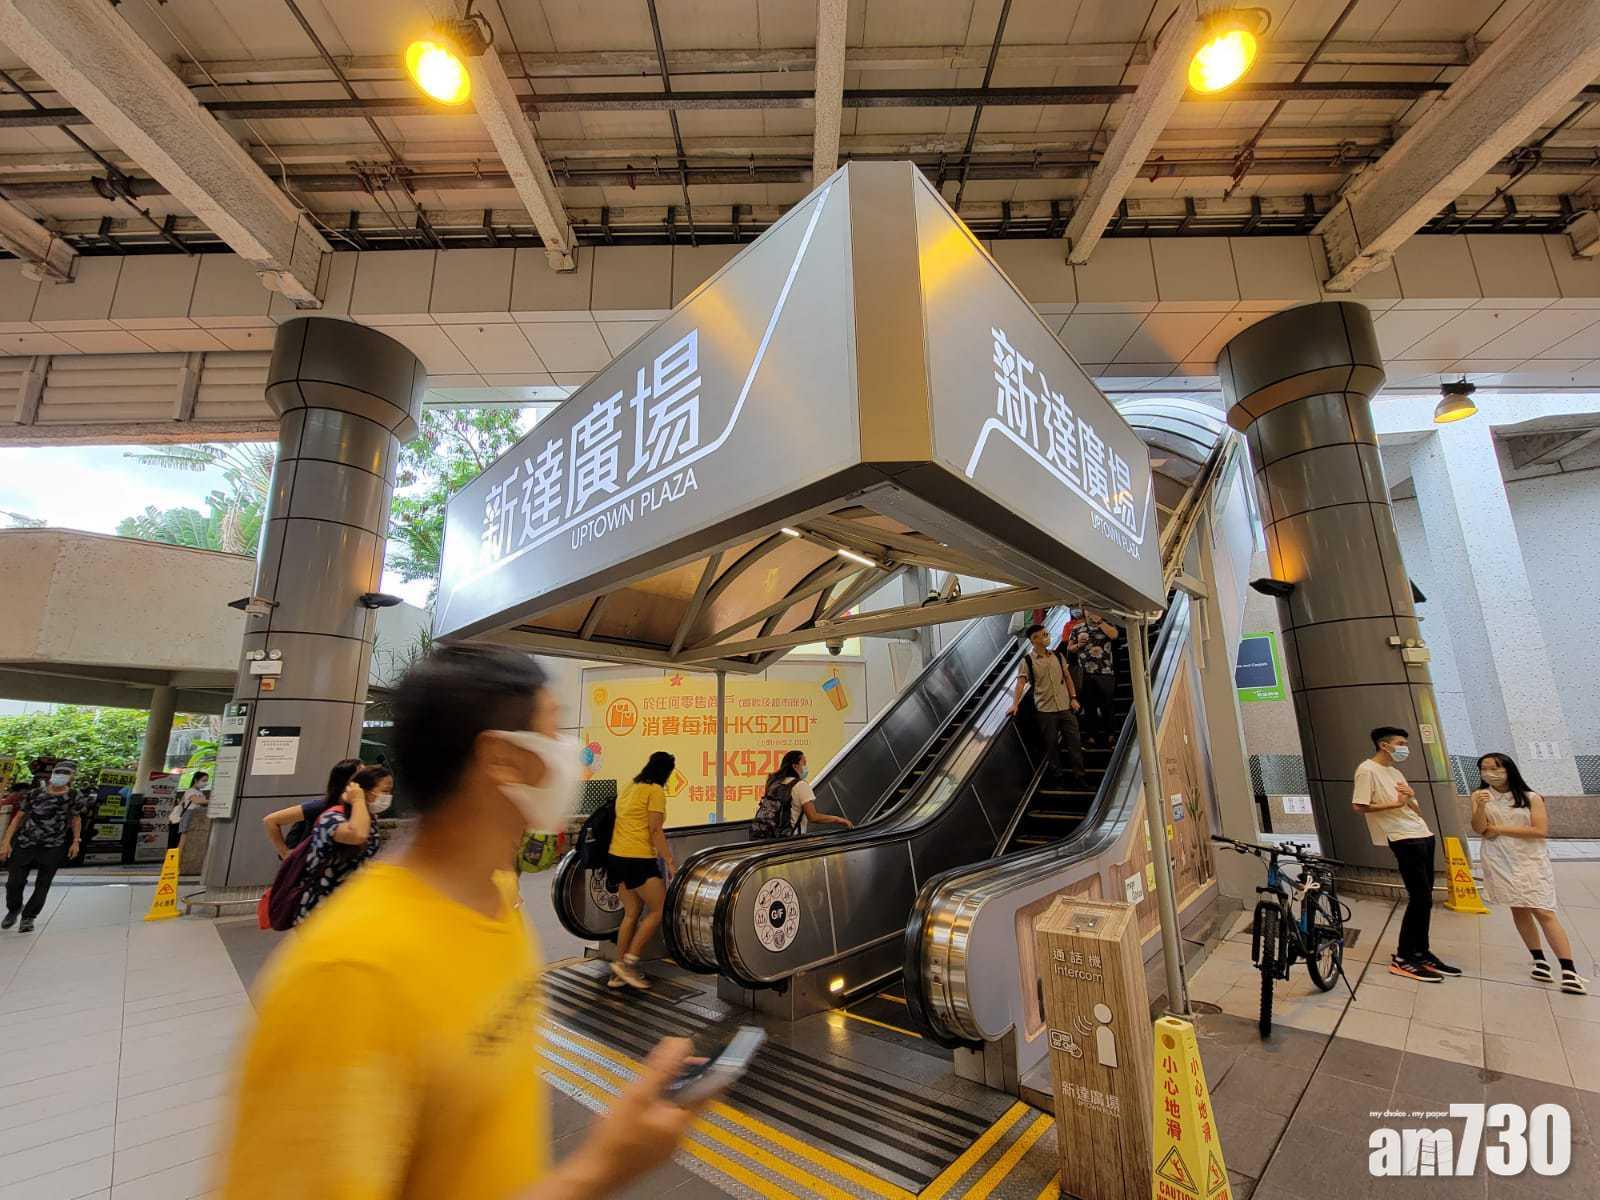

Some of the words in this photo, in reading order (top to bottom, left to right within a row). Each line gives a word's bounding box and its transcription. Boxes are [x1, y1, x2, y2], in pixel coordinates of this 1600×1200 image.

[480, 327, 702, 568] 新達廣場
[991, 327, 1137, 533] 新達廣場
[570, 498, 635, 551] UPTOWN
[640, 468, 698, 517] PLAZA
[1052, 948, 1102, 969] 通話機
[1054, 963, 1103, 982] Intercom
[1163, 1055, 1182, 1141] 小心地滑
[1190, 1057, 1212, 1144] 小心地滑
[1159, 1181, 1197, 1200] CAUTIO
